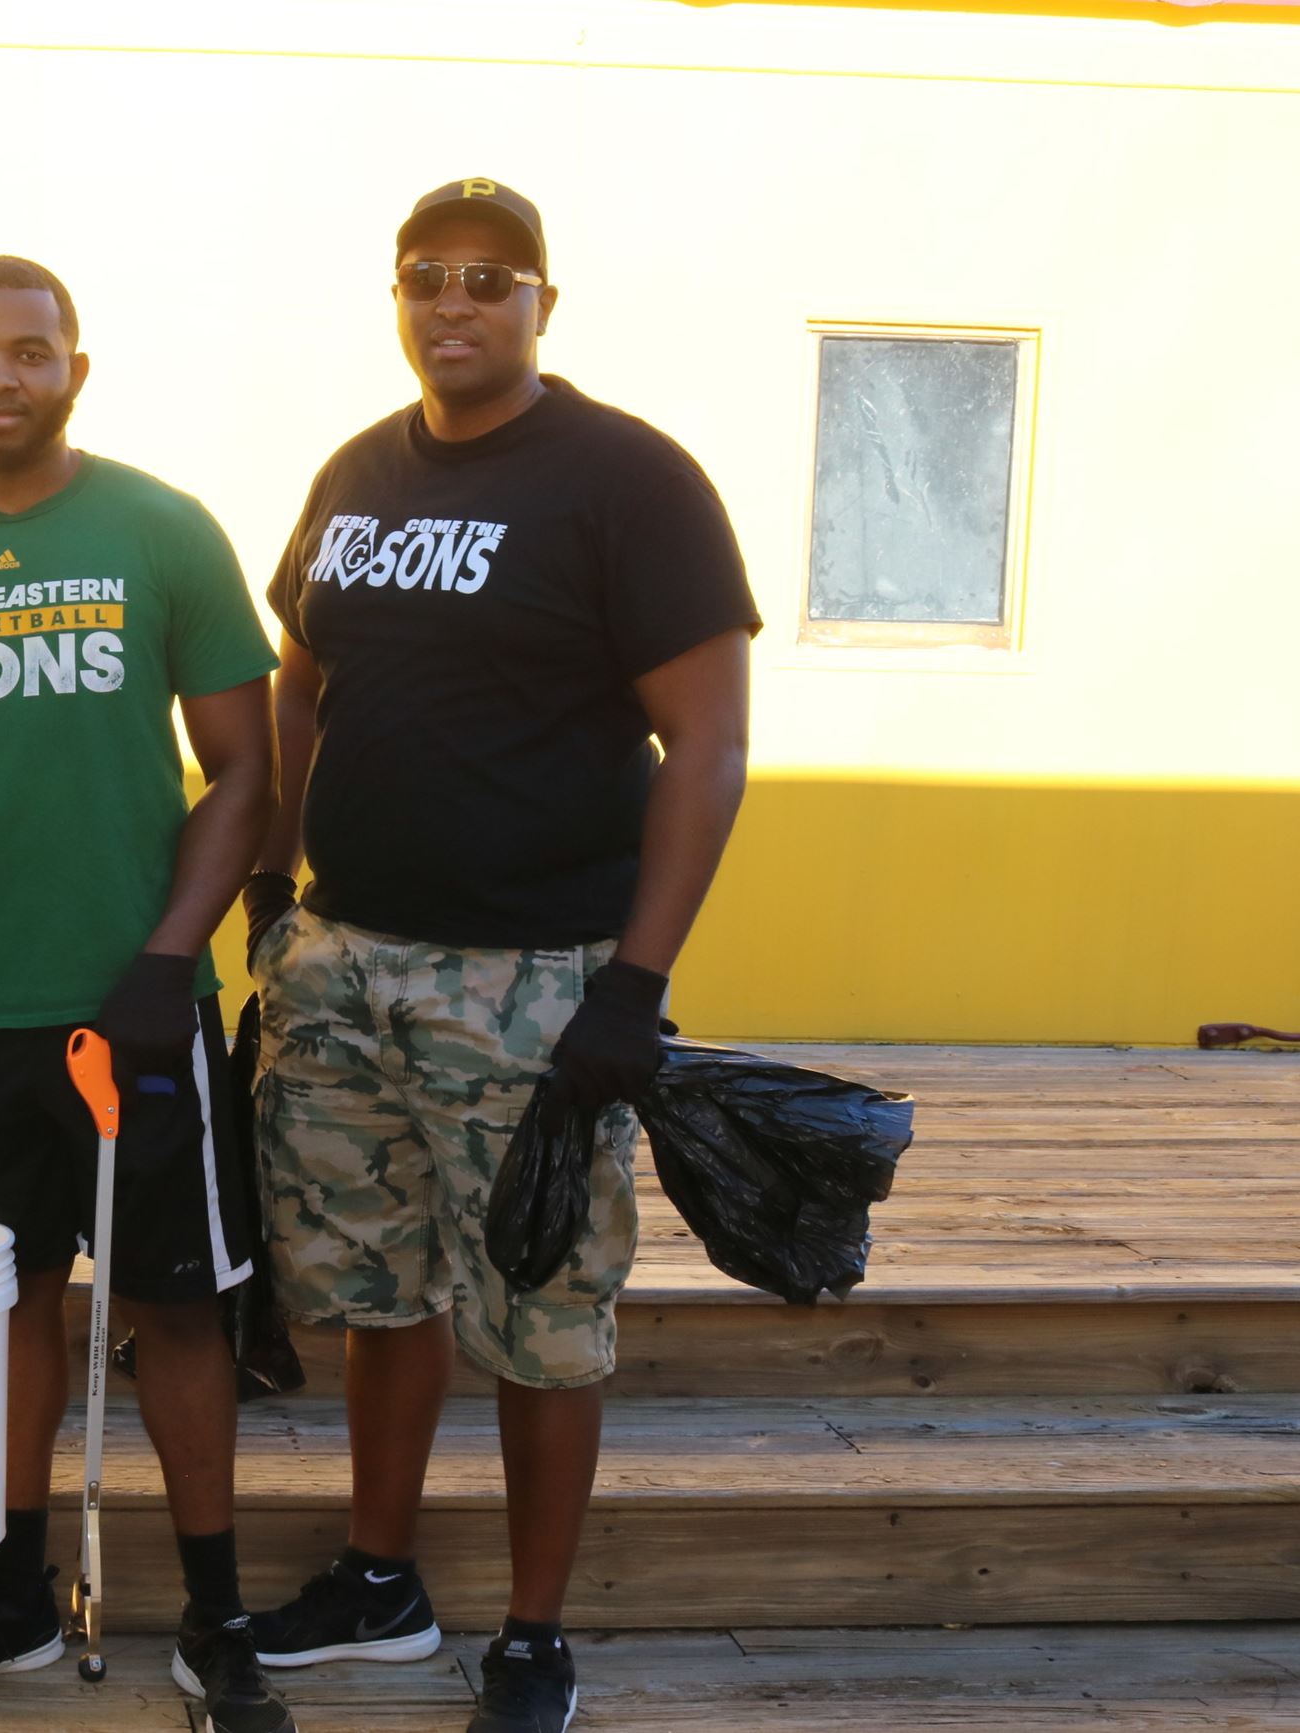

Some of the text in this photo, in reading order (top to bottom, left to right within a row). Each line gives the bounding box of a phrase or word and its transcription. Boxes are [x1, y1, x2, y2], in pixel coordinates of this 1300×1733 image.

[461, 179, 496, 198] P
[329, 515, 508, 539] HERE COME THE
